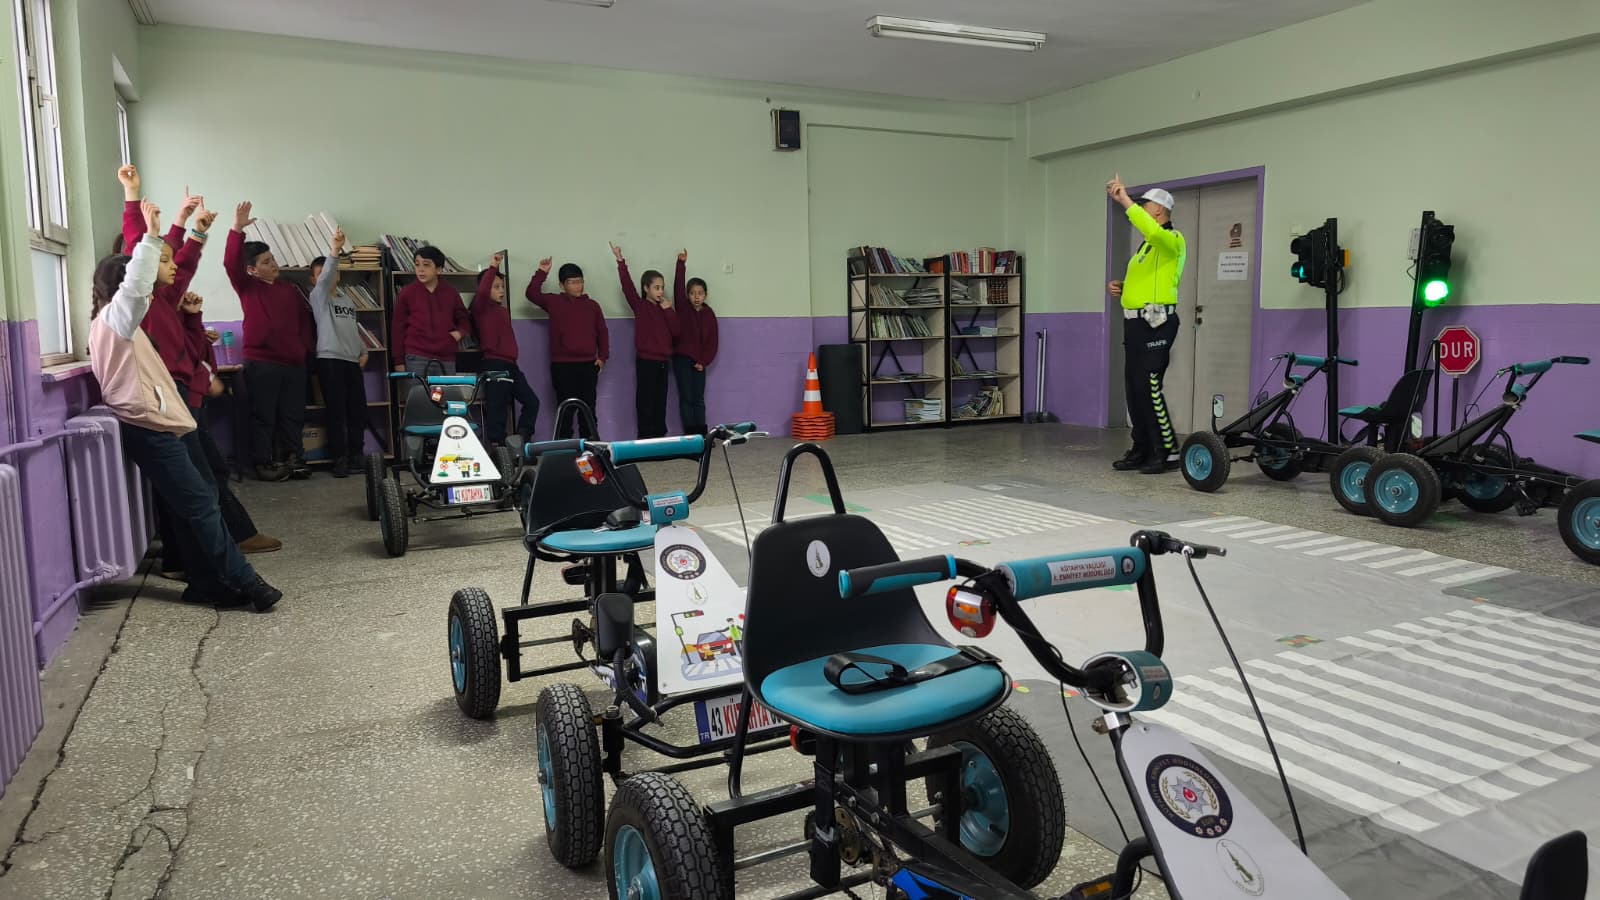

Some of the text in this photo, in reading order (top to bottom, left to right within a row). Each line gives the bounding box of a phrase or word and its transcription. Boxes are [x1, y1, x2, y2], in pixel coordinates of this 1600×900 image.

[1440, 341, 1473, 359] DUR
[711, 707, 723, 737] 43
[723, 698, 770, 735] KÜTHYA
[700, 731, 711, 741] TR
